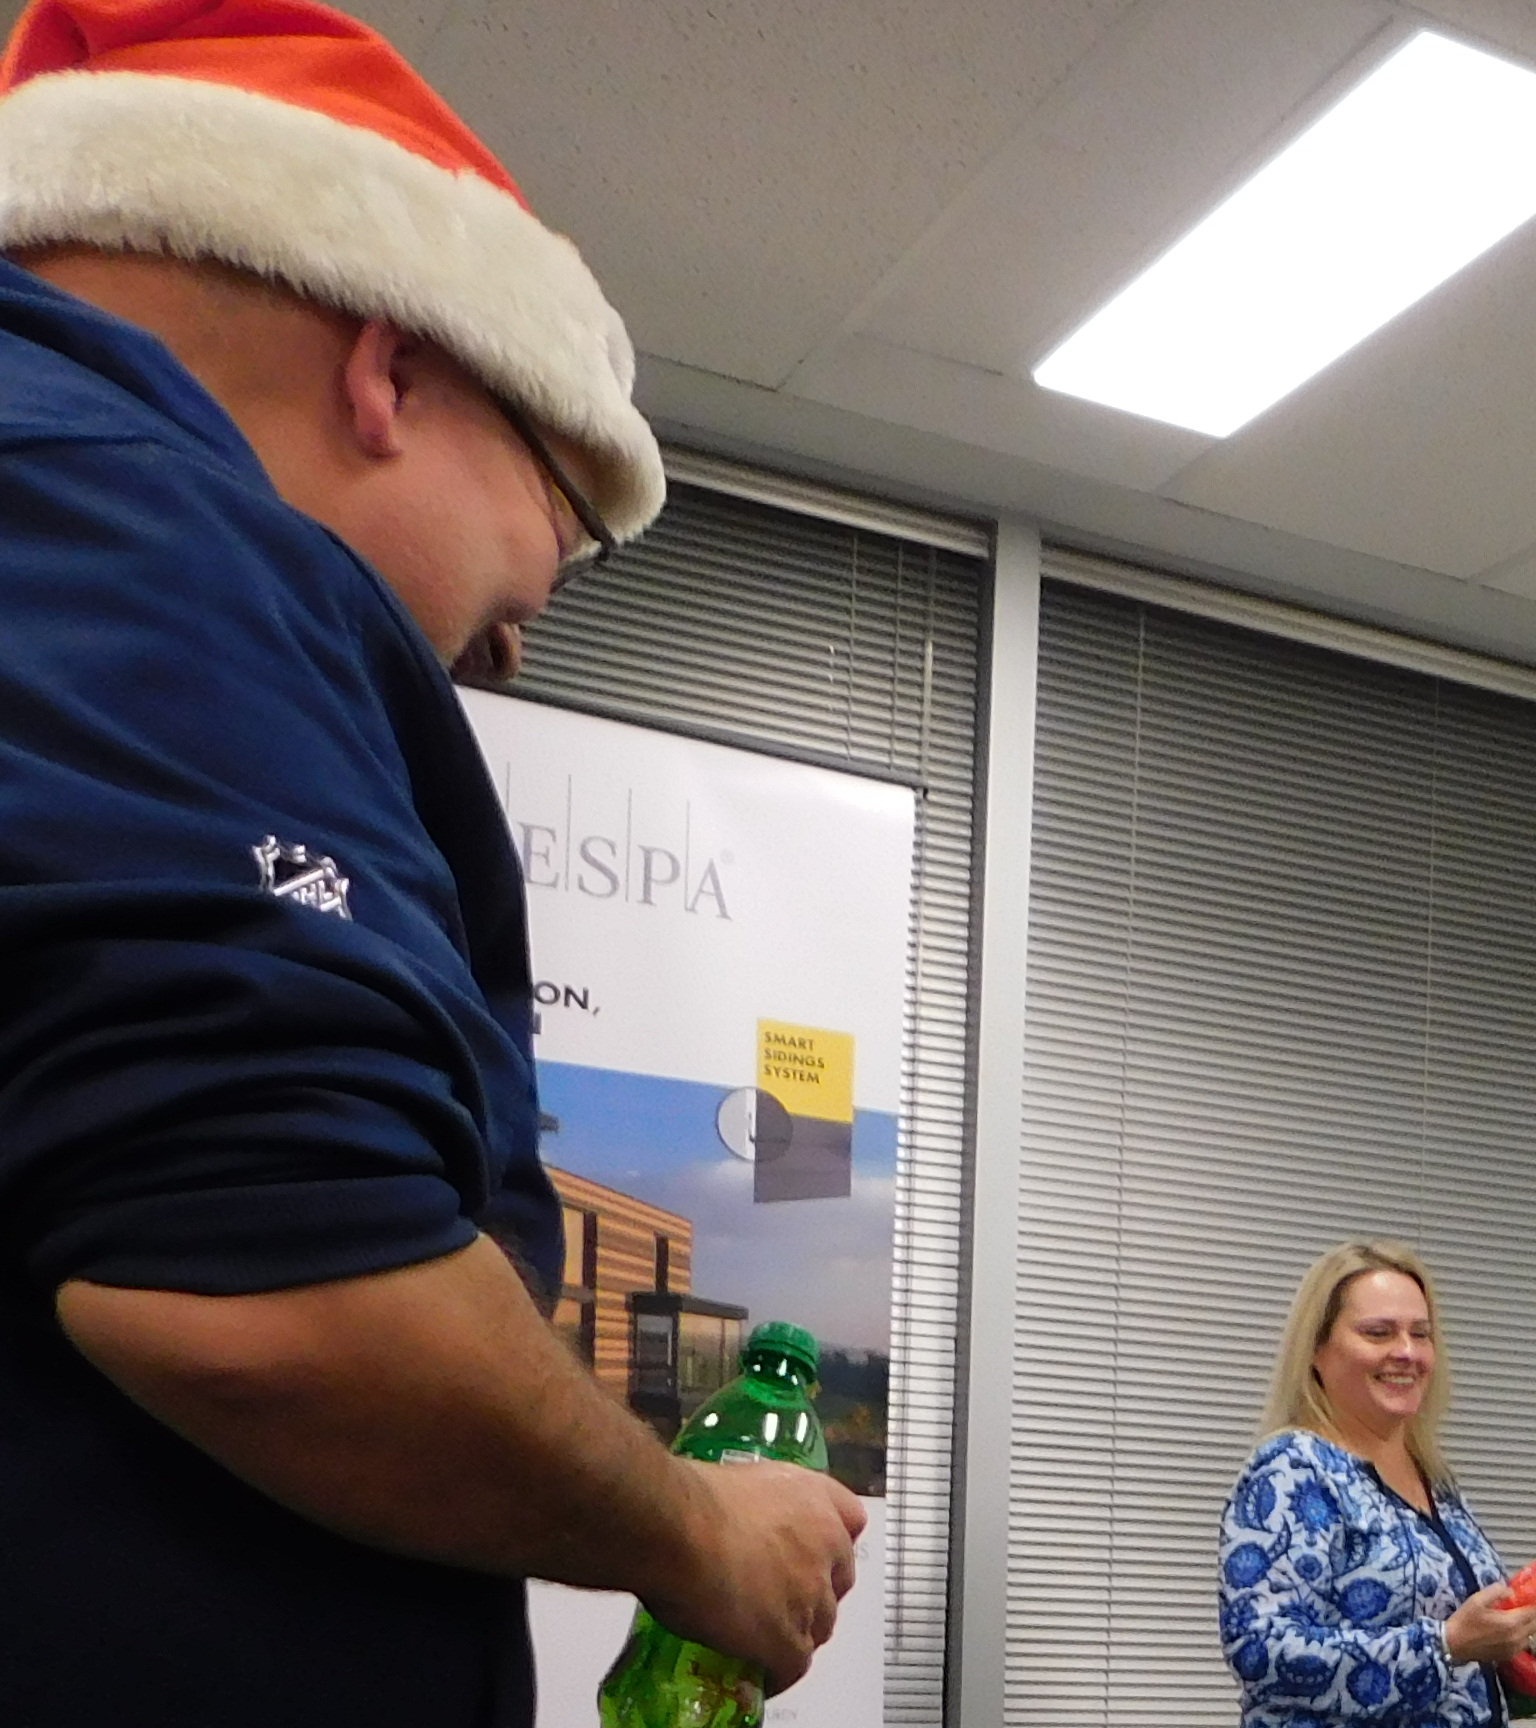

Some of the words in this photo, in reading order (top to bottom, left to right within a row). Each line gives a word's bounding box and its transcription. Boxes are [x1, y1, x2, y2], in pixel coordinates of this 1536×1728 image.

[517, 821, 733, 922] ESPA
[534, 979, 601, 1017] ON,
[763, 1031, 815, 1051] SMART
[763, 1048, 825, 1069] SIDINGS
[763, 1063, 821, 1084] SYSTEM
